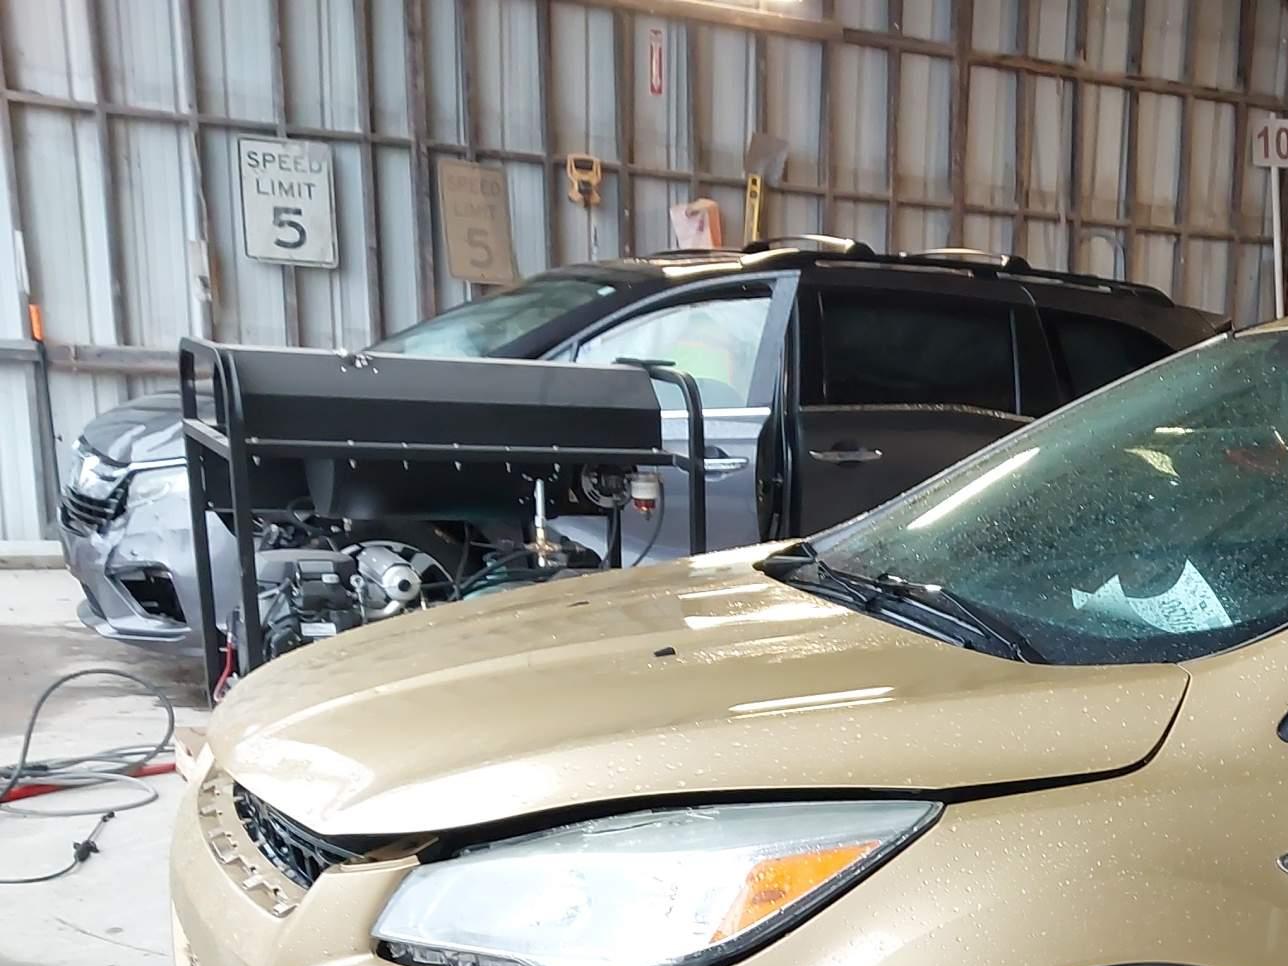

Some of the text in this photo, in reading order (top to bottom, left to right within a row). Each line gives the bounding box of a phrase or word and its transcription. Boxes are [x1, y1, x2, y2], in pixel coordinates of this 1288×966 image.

[247, 150, 322, 173] SPEED
[255, 177, 316, 200] LIMIT
[447, 174, 502, 198] SPEED
[272, 206, 307, 249] 5
[466, 226, 494, 269] 5
